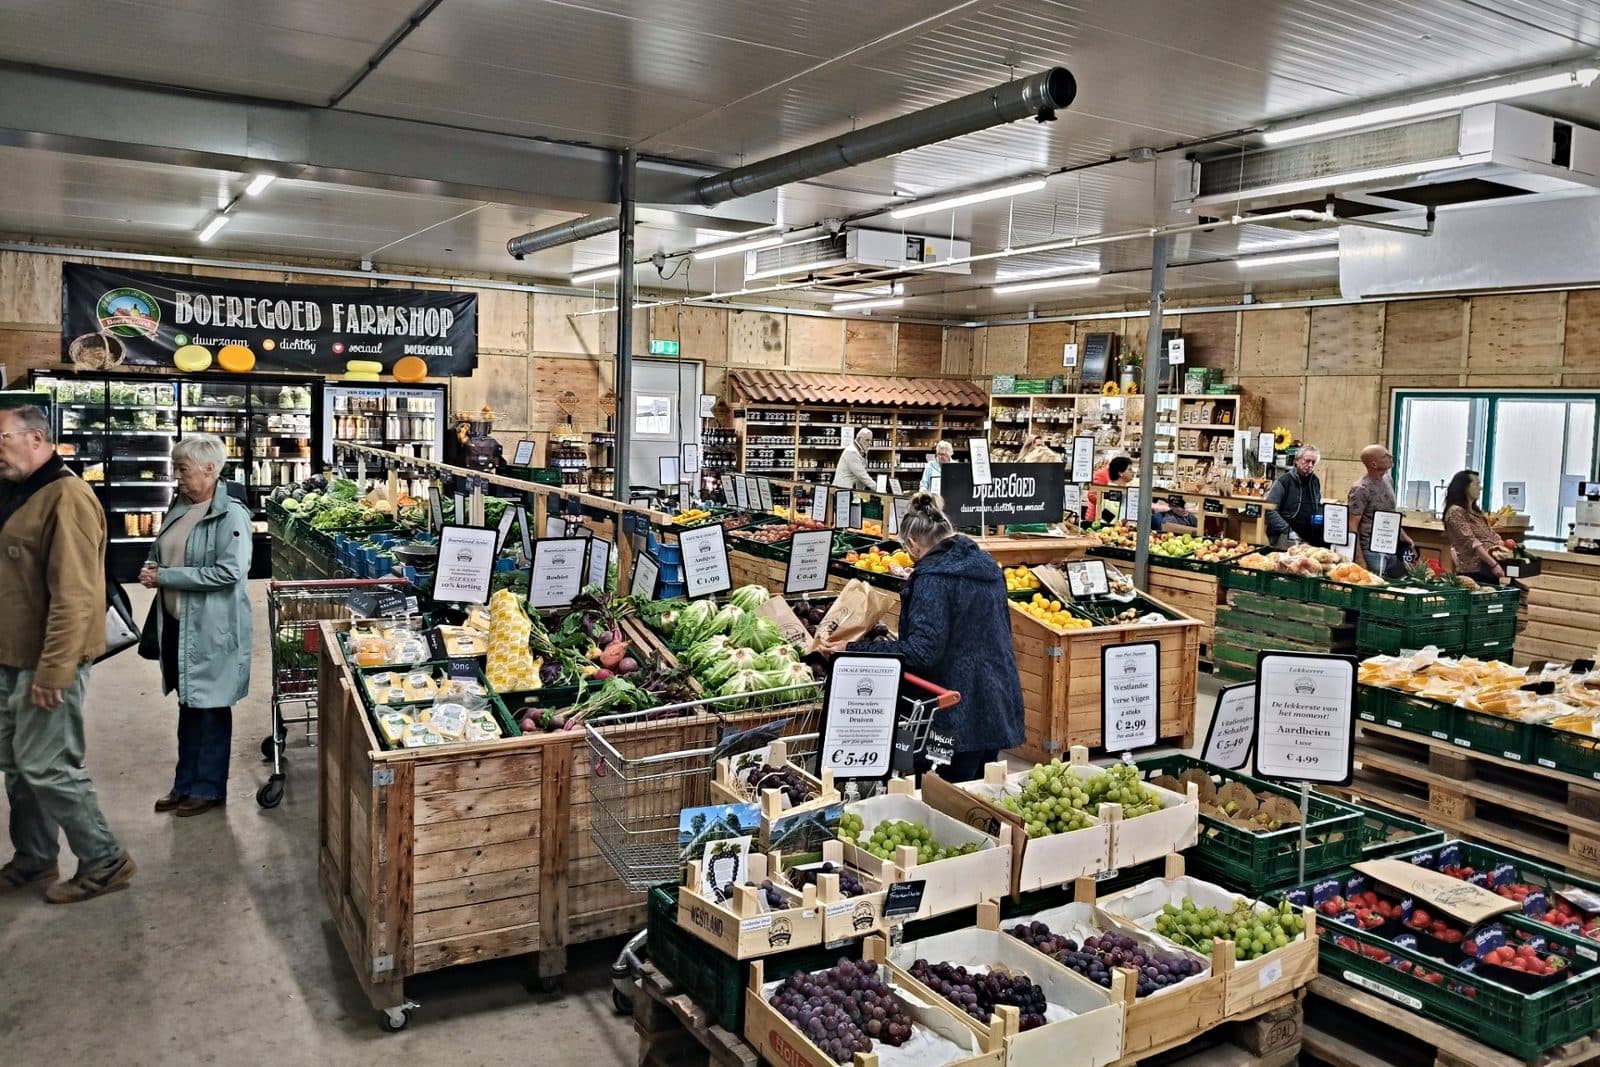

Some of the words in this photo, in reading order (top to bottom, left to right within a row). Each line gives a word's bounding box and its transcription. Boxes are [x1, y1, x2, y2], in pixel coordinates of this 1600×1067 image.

[175, 292, 322, 333] BOEREGOED
[332, 303, 455, 338] FARMSHOP
[192, 334, 249, 348] duurzaam
[279, 337, 317, 355] dichtbij
[348, 342, 383, 355] sociaal
[456, 582, 482, 591] korting
[1114, 682, 1149, 692] Westlandse
[1112, 696, 1130, 704] Verse
[1130, 694, 1150, 703] Vijgen
[1284, 702, 1321, 712] lekkerste
[1292, 712, 1330, 720] moment!
[1116, 720, 1123, 730] €
[1276, 725, 1331, 737] Aardbeien
[831, 749, 844, 764] €
[844, 752, 879, 766] 5,49
[1286, 752, 1294, 761] €
[776, 1036, 806, 1067] Holl
